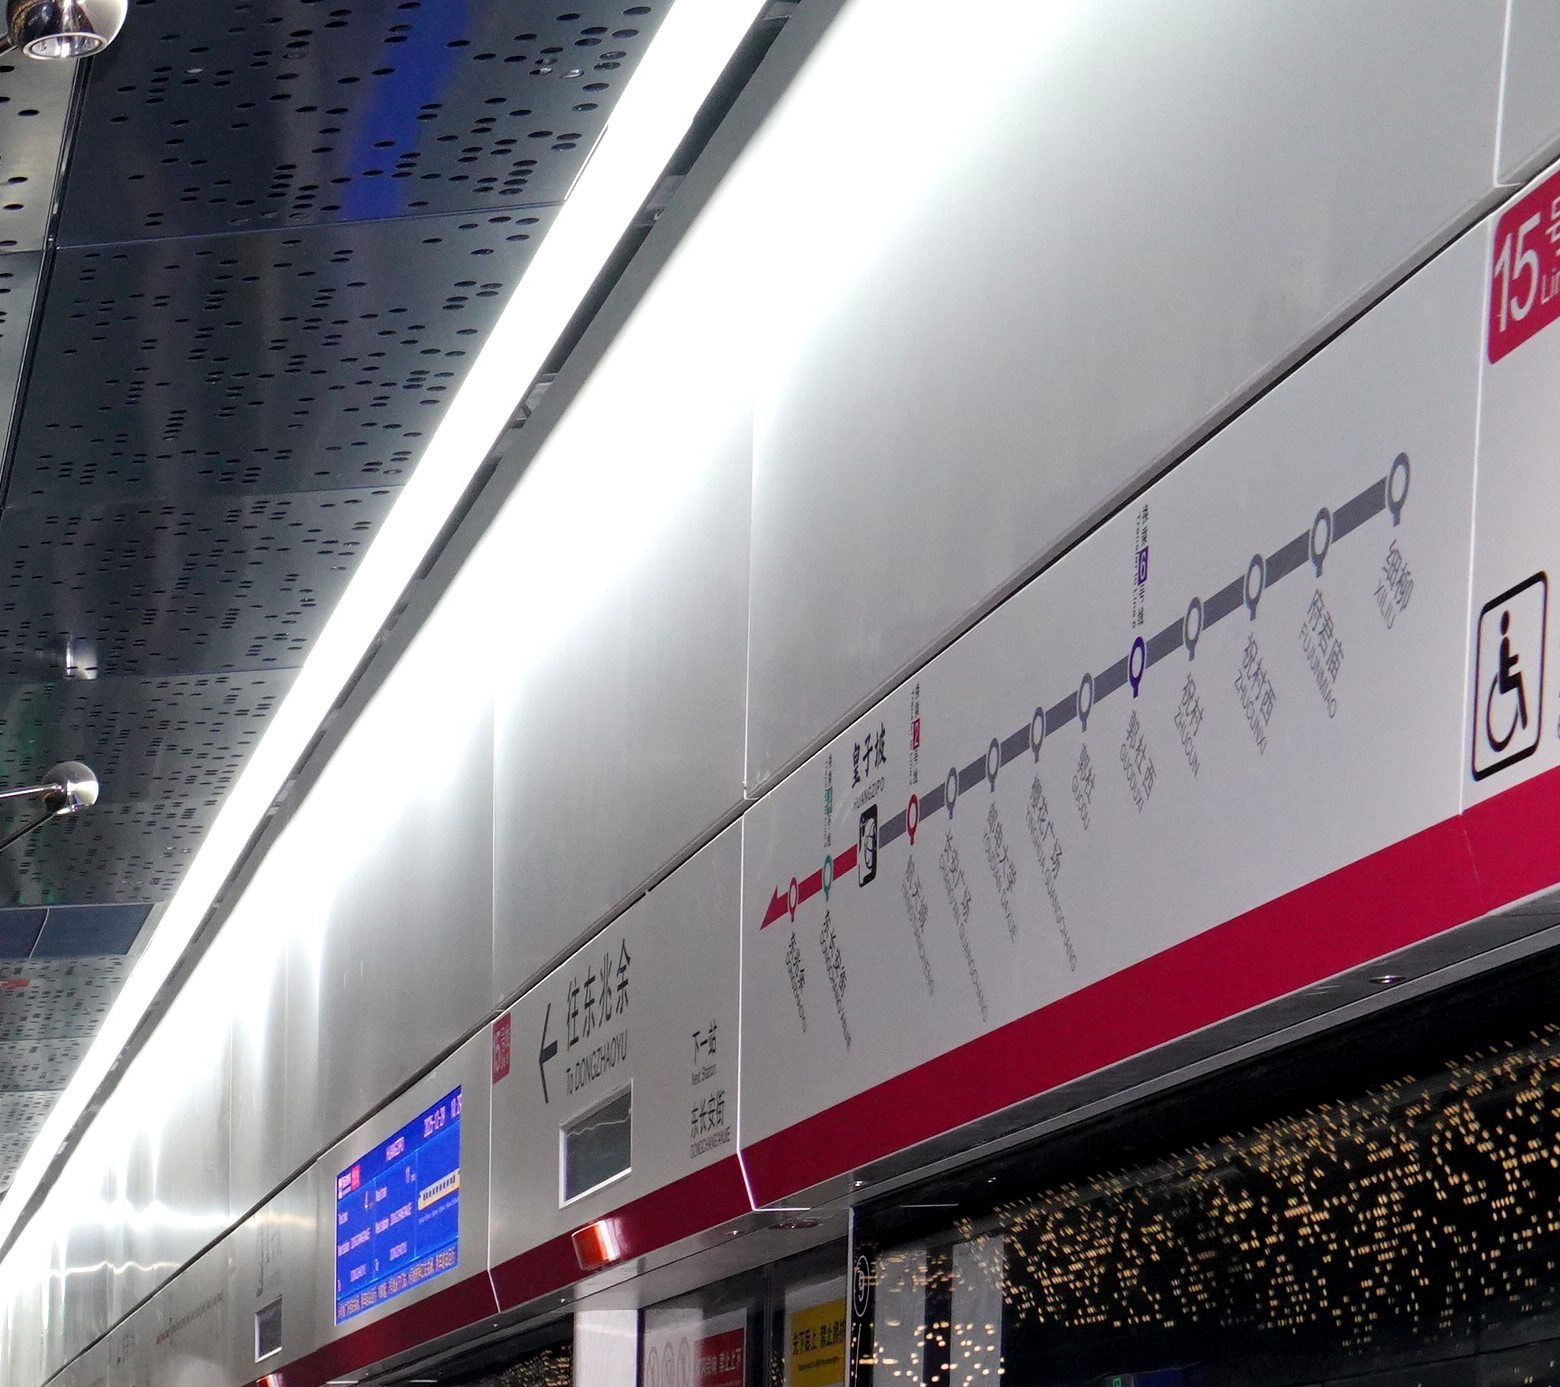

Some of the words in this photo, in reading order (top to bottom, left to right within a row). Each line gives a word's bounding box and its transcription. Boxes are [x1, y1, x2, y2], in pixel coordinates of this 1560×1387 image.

[1494, 212, 1541, 333] 15
[1373, 579, 1396, 630] XILIU
[1382, 539, 1414, 614] 细柳
[1299, 622, 1337, 719] FUJUNMIAO
[1307, 588, 1345, 683] 府君庙
[566, 938, 631, 1051] 往东兆余
[575, 1029, 627, 1090] DONGZHAOYU
[691, 1018, 717, 1066] 下一站
[691, 1088, 725, 1140] 东长安街
